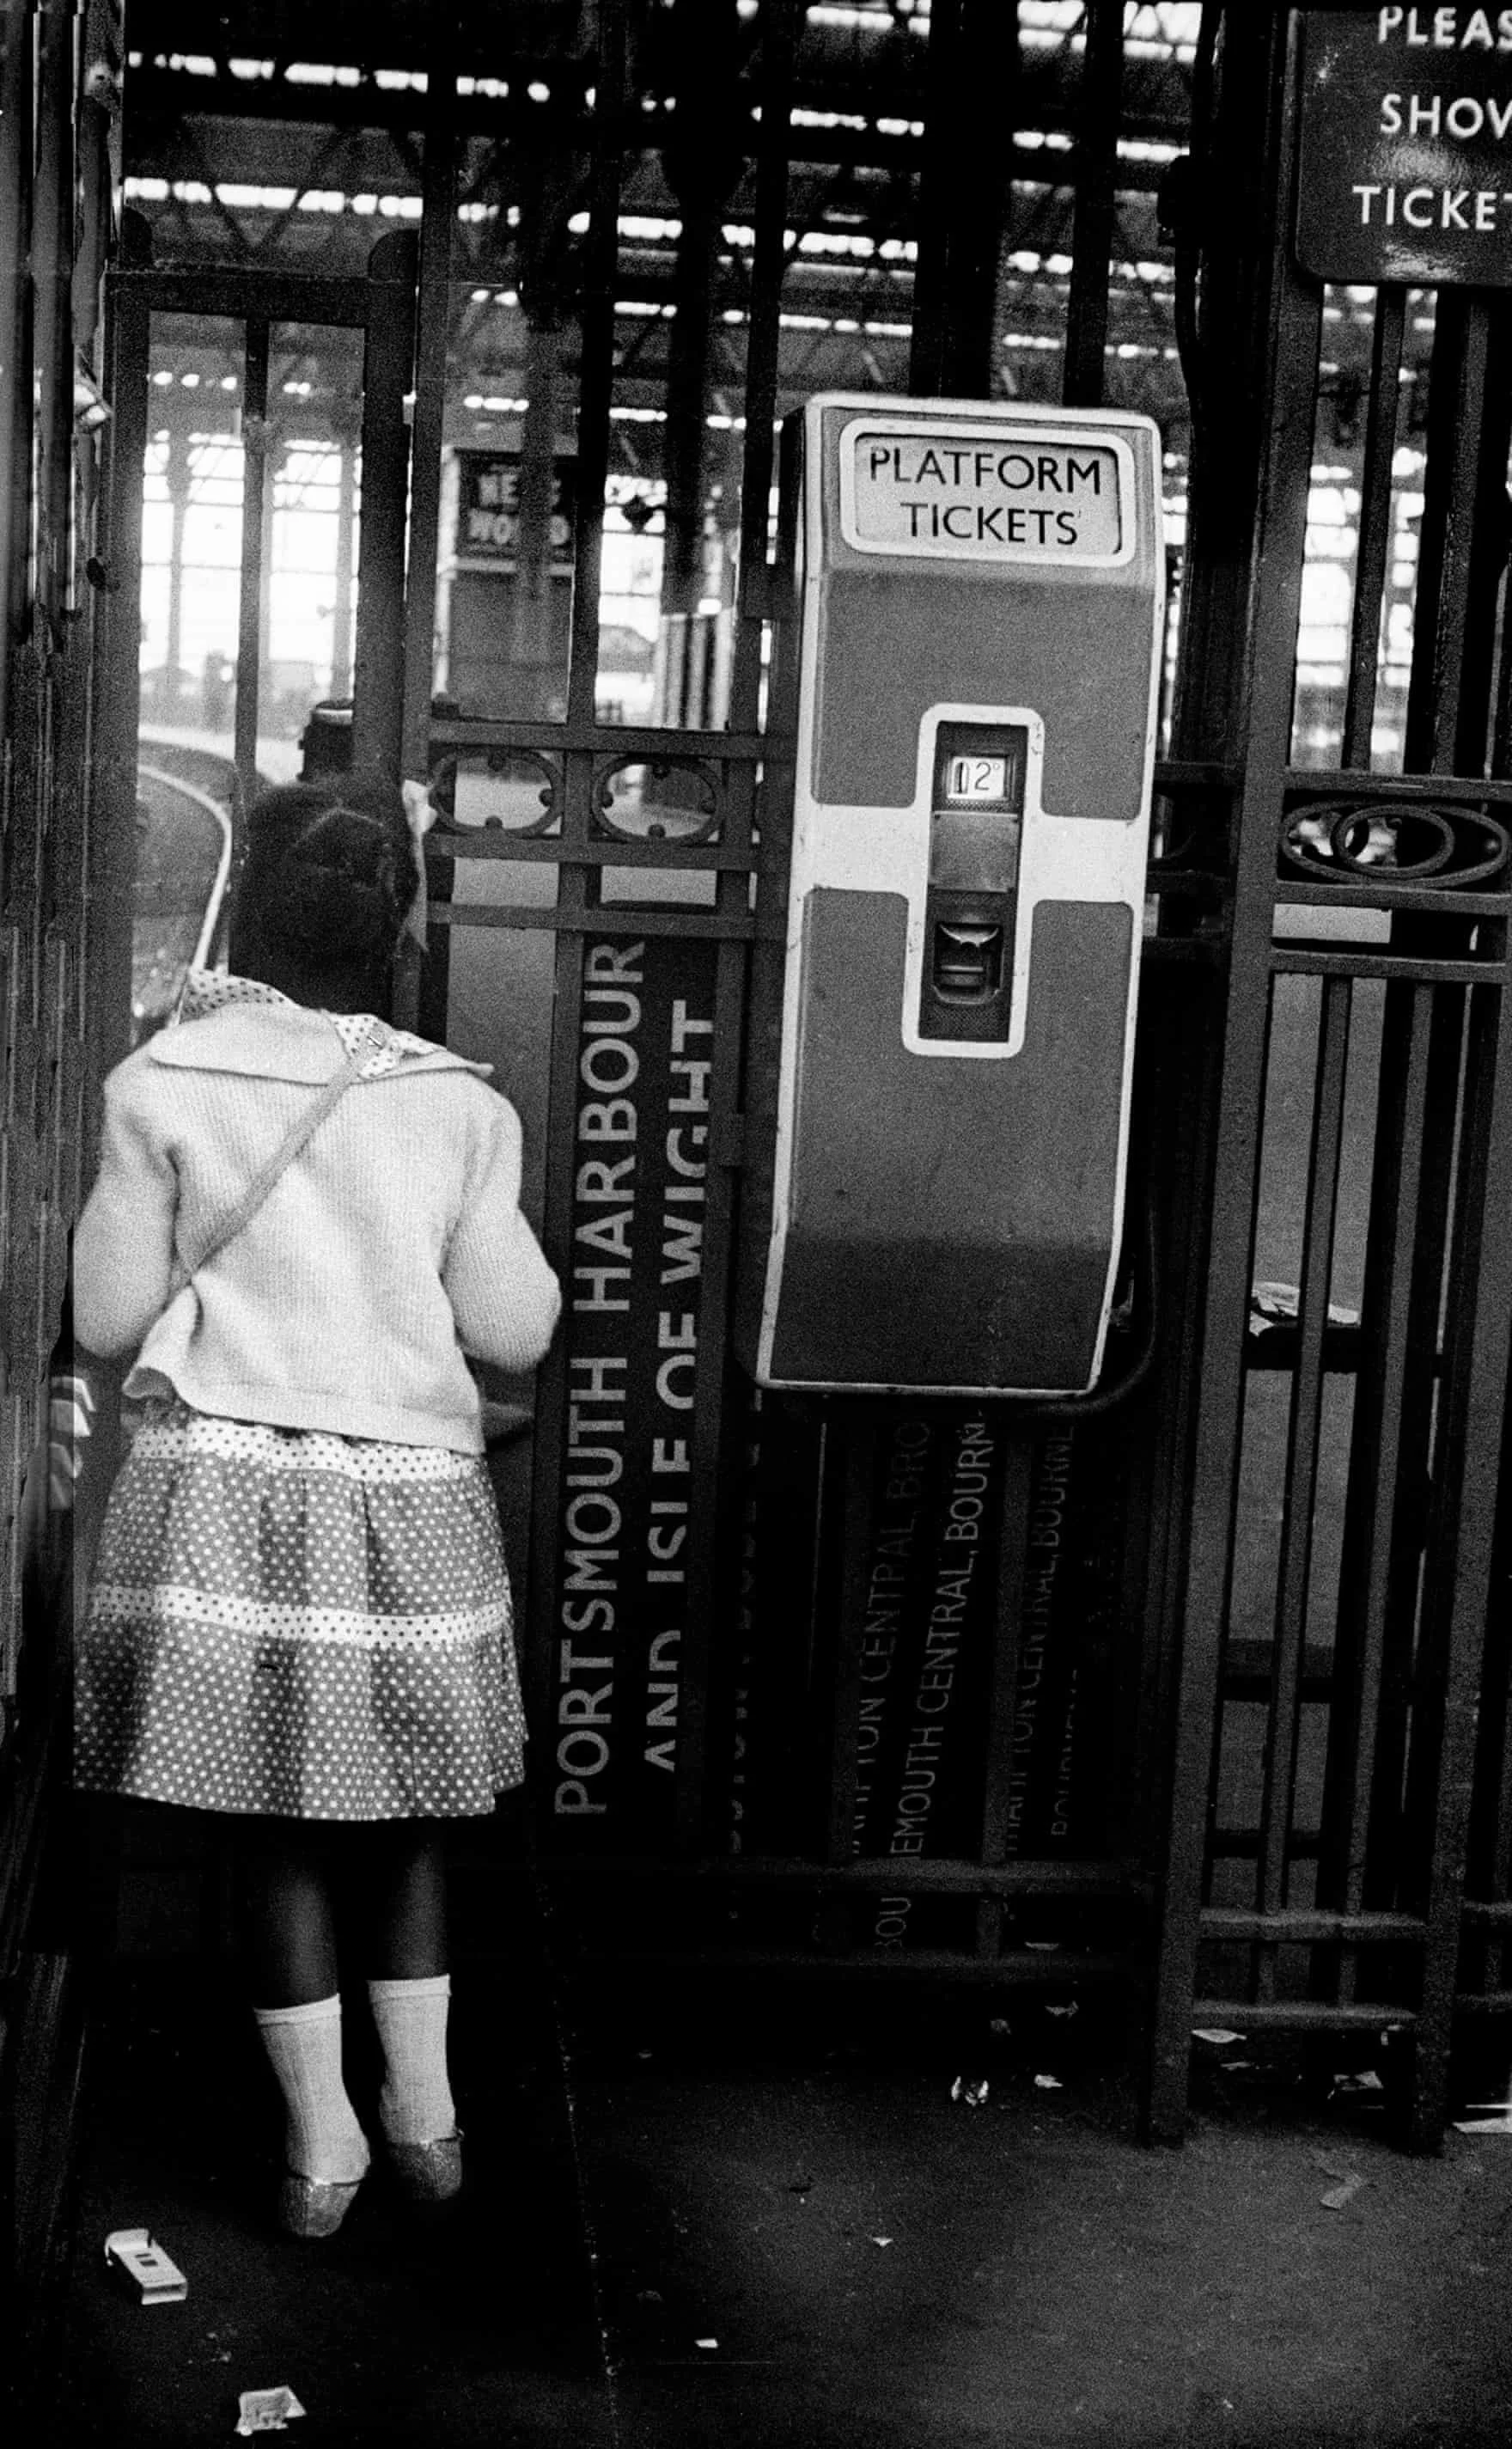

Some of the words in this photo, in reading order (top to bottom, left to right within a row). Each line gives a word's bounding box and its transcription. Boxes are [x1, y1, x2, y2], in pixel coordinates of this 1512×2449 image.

[1377, 6, 1512, 50] PLEAS
[1352, 185, 1512, 230] TICKE
[869, 446, 1100, 495] PLATFORM
[899, 503, 1078, 546] TICKETS
[572, 941, 646, 1312] HARBOUR
[660, 999, 714, 1286] WIGHT
[554, 1357, 628, 1815] PORTSMOUTH
[643, 1629, 681, 1772] AND
